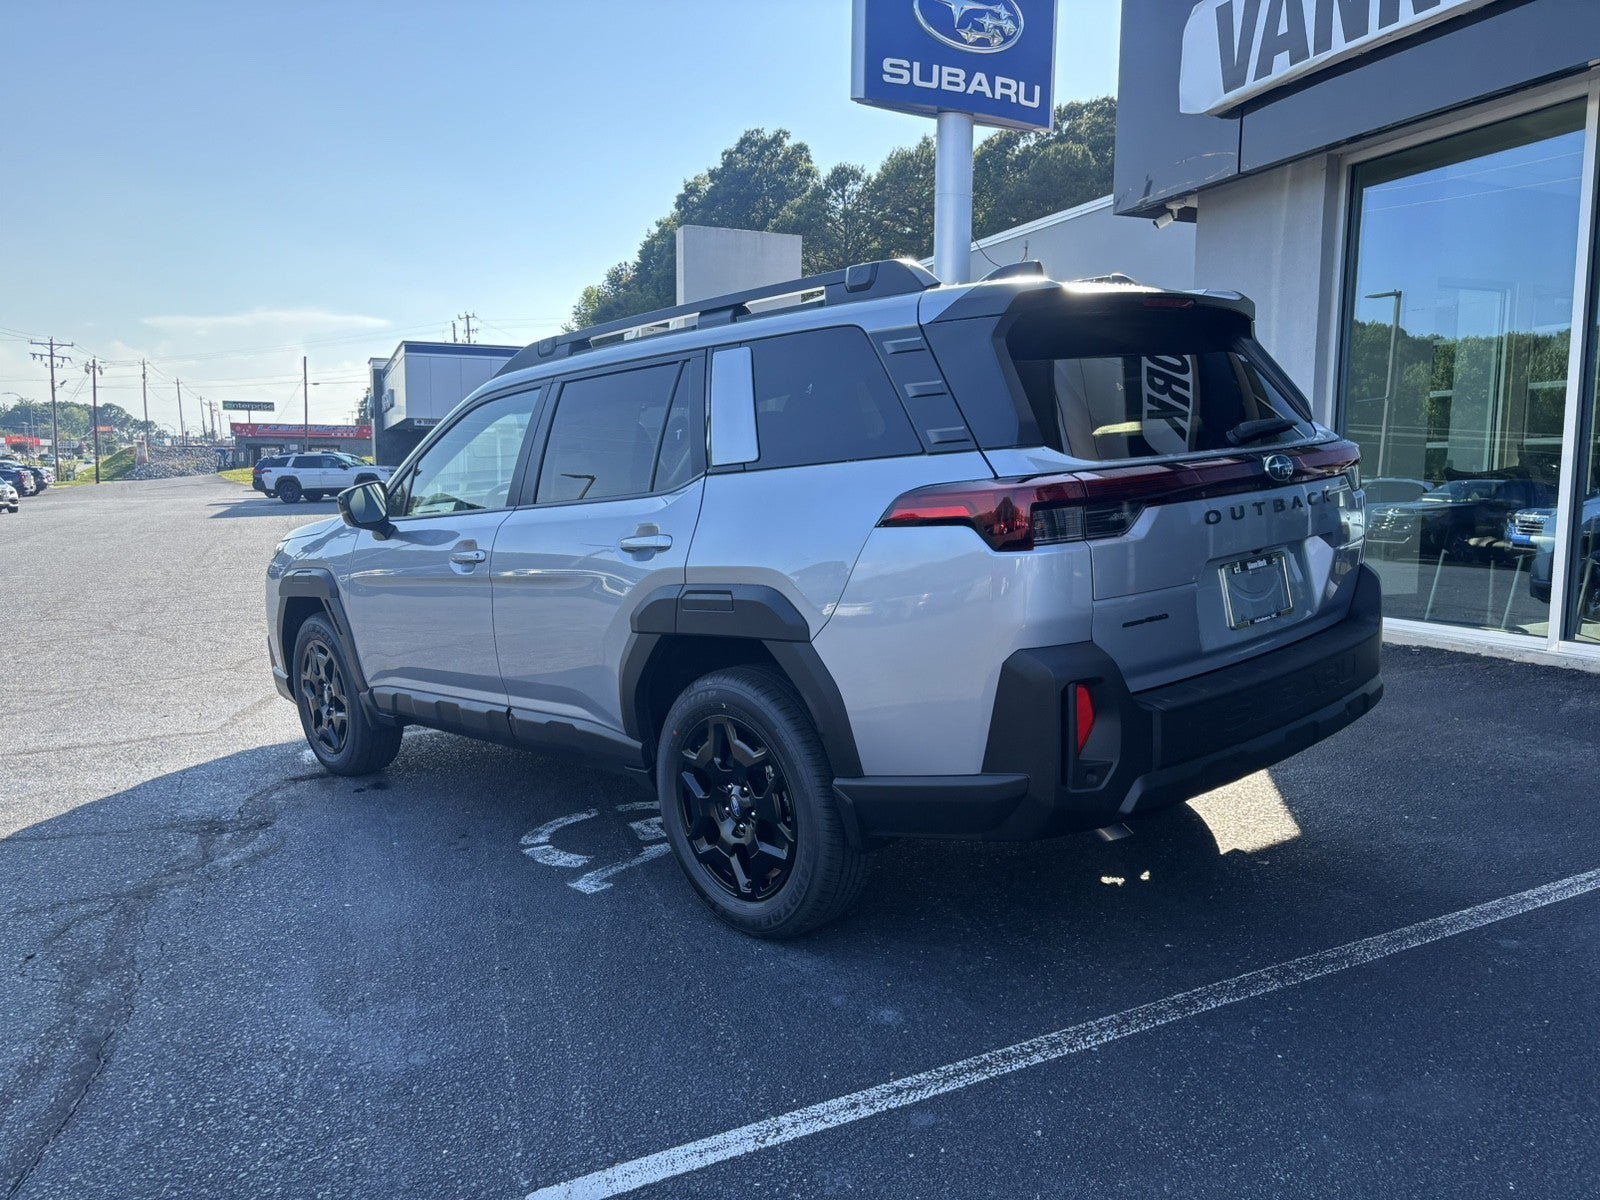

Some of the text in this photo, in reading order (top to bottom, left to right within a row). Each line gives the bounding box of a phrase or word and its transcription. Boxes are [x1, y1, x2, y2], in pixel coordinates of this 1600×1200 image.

[1215, 0, 1441, 94] VAN
[882, 57, 1041, 109] SUBARU
[224, 401, 274, 411] enterprise
[1204, 490, 1331, 525] OUTBACK
